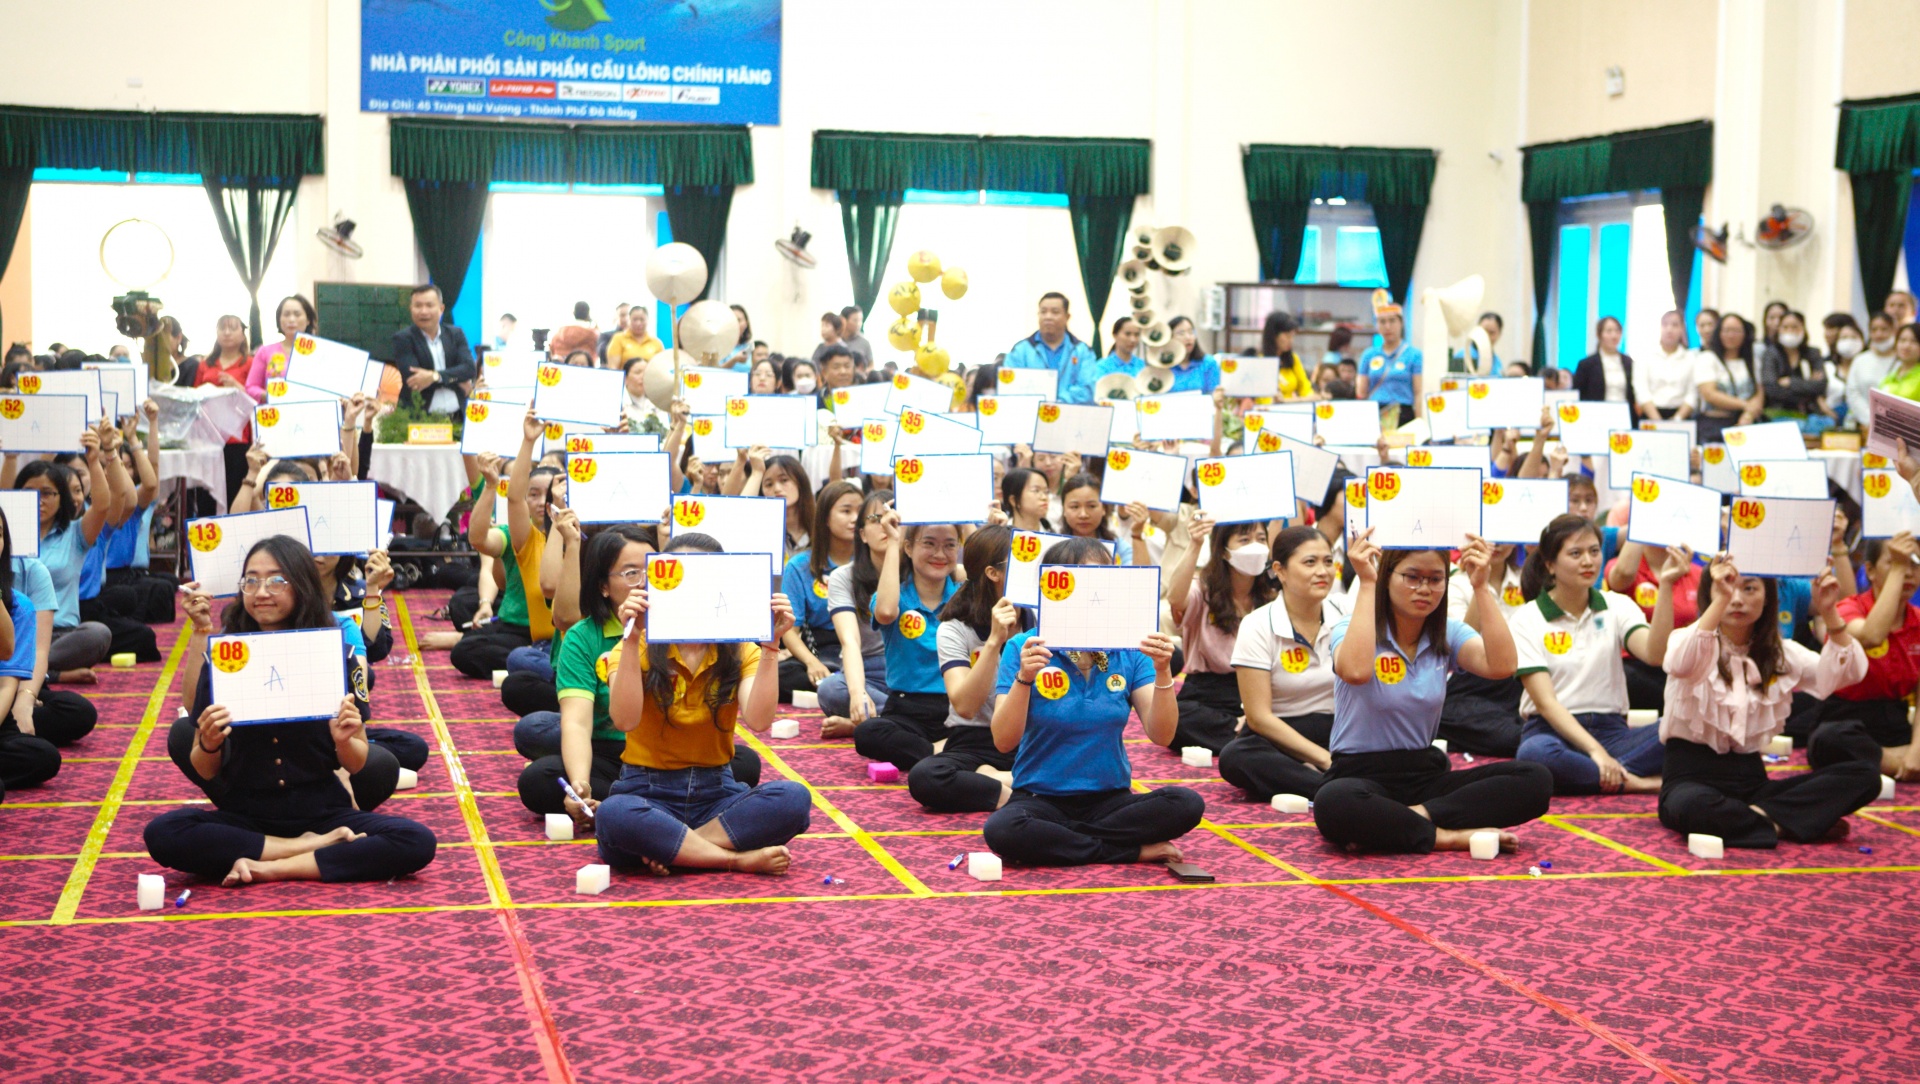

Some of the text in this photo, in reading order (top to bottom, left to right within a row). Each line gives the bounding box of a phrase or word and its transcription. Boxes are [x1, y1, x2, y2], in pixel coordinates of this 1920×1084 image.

[503, 30, 646, 54] Công Khanh Sport
[370, 50, 407, 72] NHÀ
[409, 53, 457, 74] PHÂN
[460, 53, 500, 76] PHỐI
[627, 61, 671, 82] LÔNG
[672, 62, 724, 84] CHÍNH
[450, 82, 481, 93] YONEX
[299, 337, 313, 350] 68
[542, 367, 558, 380] 47
[22, 375, 38, 388] 69
[272, 381, 285, 392] 73
[5, 399, 20, 412] 52
[470, 403, 486, 416] 54
[731, 399, 745, 411] 55
[982, 398, 996, 409] 65
[1044, 405, 1057, 417] 56
[261, 407, 276, 421] 53
[906, 411, 922, 427] 35
[1249, 414, 1260, 425] 57
[31, 420, 40, 433] A
[698, 419, 710, 431] 75
[868, 424, 883, 436] 46
[572, 438, 589, 452] 34
[1263, 433, 1277, 448] 44
[1614, 433, 1628, 446] 38
[1112, 451, 1127, 464] 45
[1413, 450, 1428, 463] 37
[574, 458, 592, 473] 27
[901, 459, 919, 474] 26
[1204, 463, 1221, 478] 25
[1746, 465, 1762, 479] 23
[1374, 472, 1395, 490] 05
[1639, 478, 1655, 494] 17
[1870, 473, 1887, 488] 18
[275, 487, 294, 503] 28
[1483, 482, 1499, 496] 24
[681, 500, 700, 517] 14
[1739, 501, 1760, 518] 04
[314, 515, 329, 529] A
[1412, 519, 1423, 535] A
[195, 522, 217, 542] 13
[1787, 525, 1801, 549] A
[1019, 535, 1037, 553] 15
[654, 559, 677, 579] 07
[1047, 571, 1069, 590] 06
[715, 591, 729, 617] A
[1089, 591, 1106, 607] A
[904, 614, 921, 630] 26
[1550, 631, 1565, 646] 17
[219, 641, 243, 661] 08
[1286, 648, 1304, 664] 16
[1380, 656, 1400, 674] 05
[264, 665, 285, 691] A
[1041, 671, 1063, 690] 06
